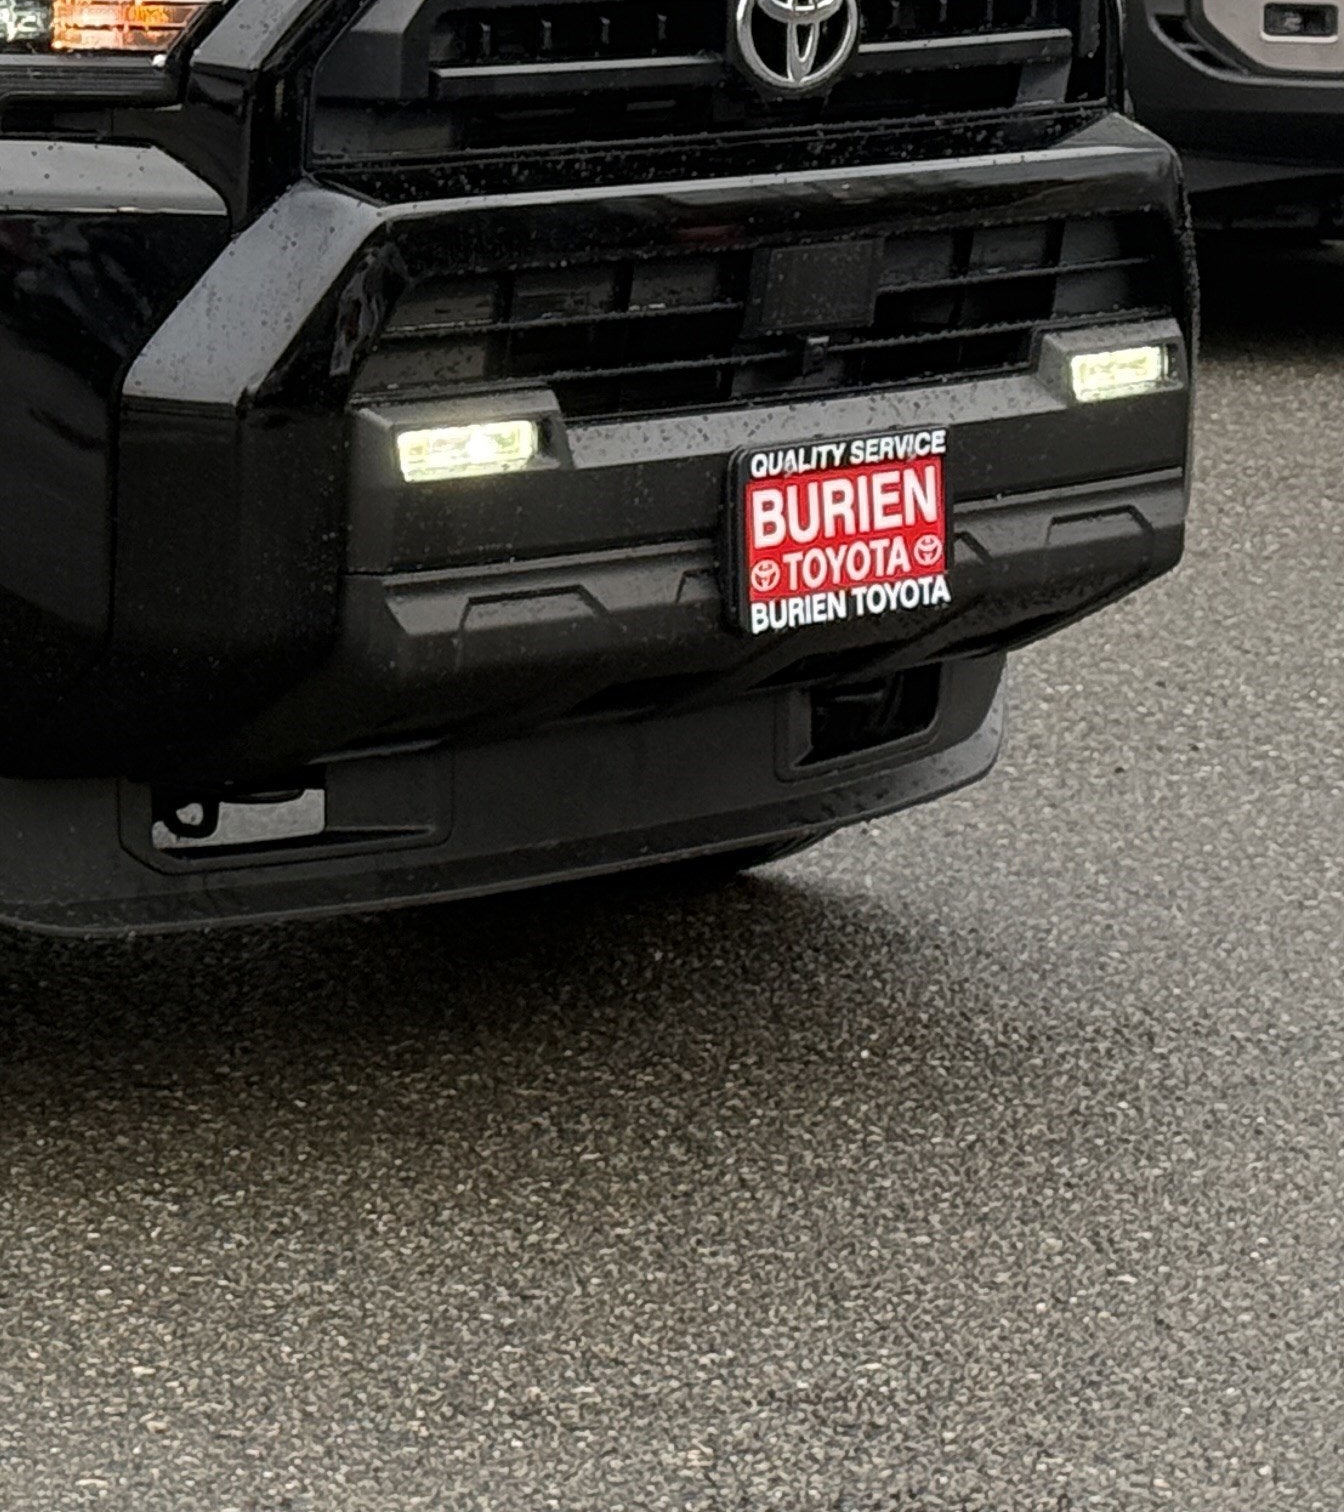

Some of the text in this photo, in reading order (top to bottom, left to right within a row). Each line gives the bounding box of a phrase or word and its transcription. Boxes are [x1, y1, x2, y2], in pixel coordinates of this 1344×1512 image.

[750, 430, 947, 478] QUALITY SERVICE
[752, 465, 938, 549] BURIEN
[782, 535, 911, 590] TOYOTA
[750, 574, 952, 635] BURIEN TOYOTA
